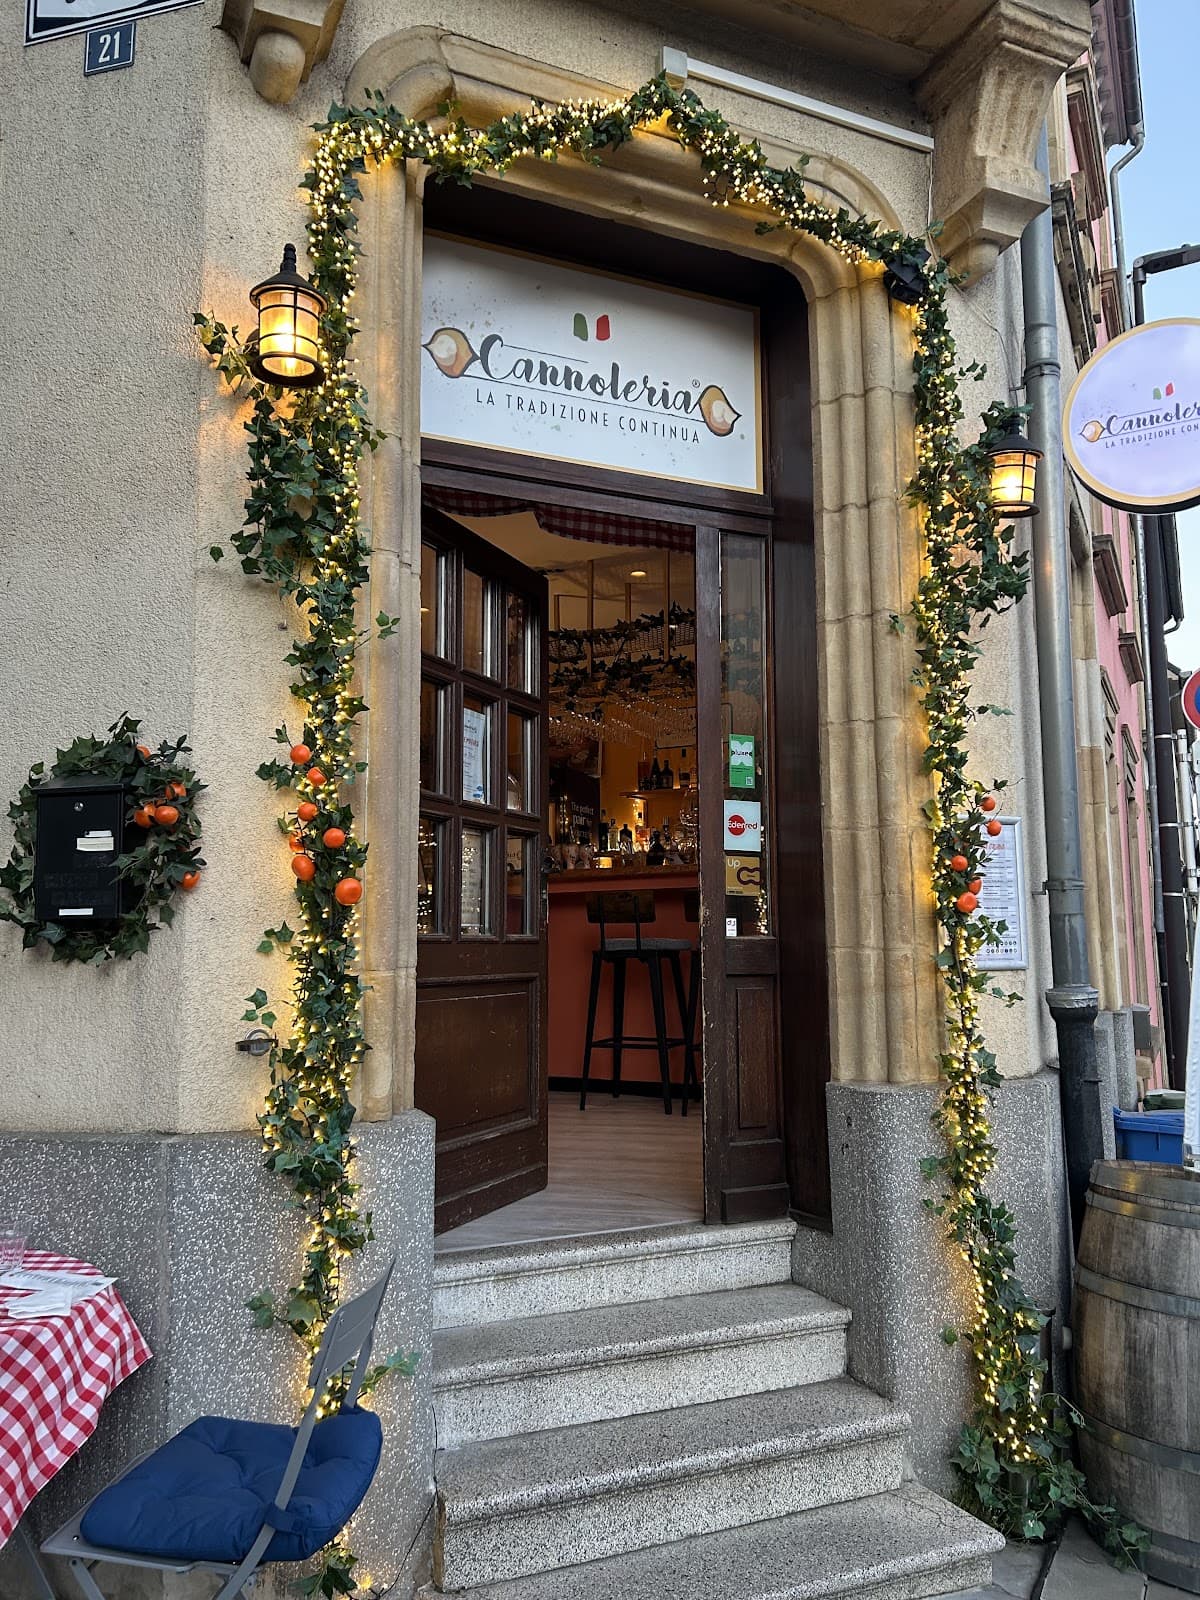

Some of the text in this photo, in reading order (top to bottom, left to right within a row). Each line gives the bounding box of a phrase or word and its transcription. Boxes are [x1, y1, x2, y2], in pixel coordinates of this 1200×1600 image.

[98, 31, 121, 63] 21
[476, 388, 700, 444] LA TRADIZIONE CONTINUA
[1105, 441, 1116, 449] LA
[1119, 428, 1176, 446] TRADIZIONE
[728, 820, 758, 830] Edenred
[727, 858, 741, 869] Up
